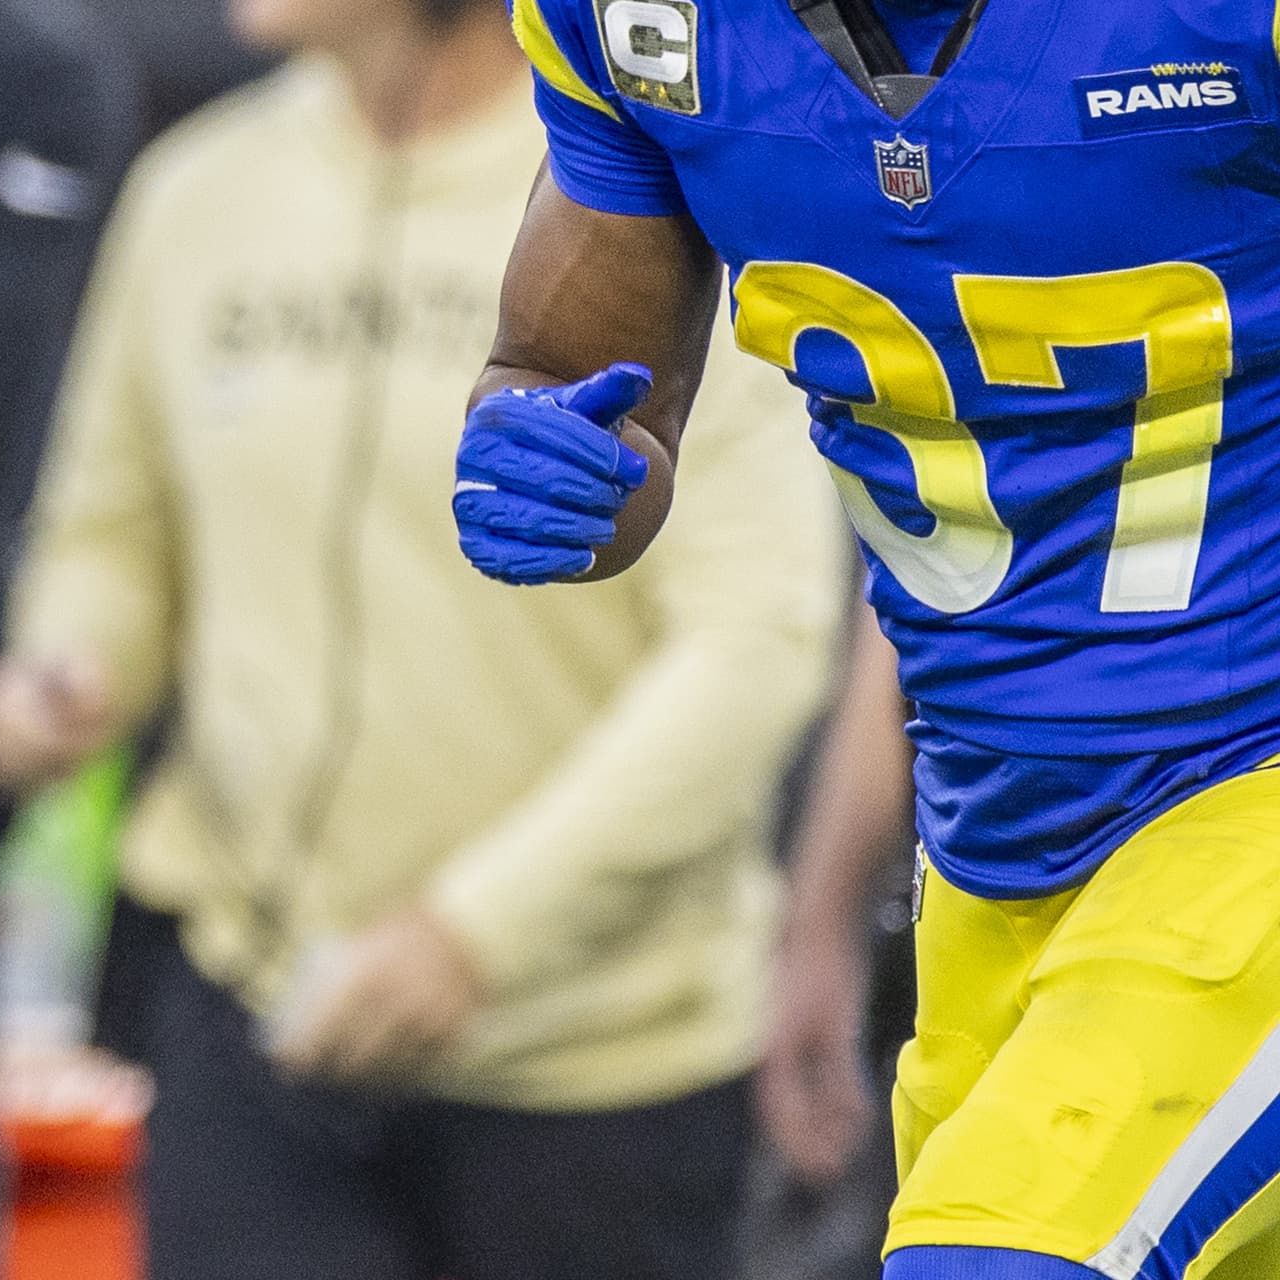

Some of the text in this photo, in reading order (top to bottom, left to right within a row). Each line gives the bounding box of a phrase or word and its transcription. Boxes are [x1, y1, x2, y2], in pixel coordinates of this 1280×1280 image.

[604, 0, 689, 84] C
[1086, 80, 1238, 118] RAMS
[886, 170, 924, 197] NFL
[734, 261, 1233, 614] 37
